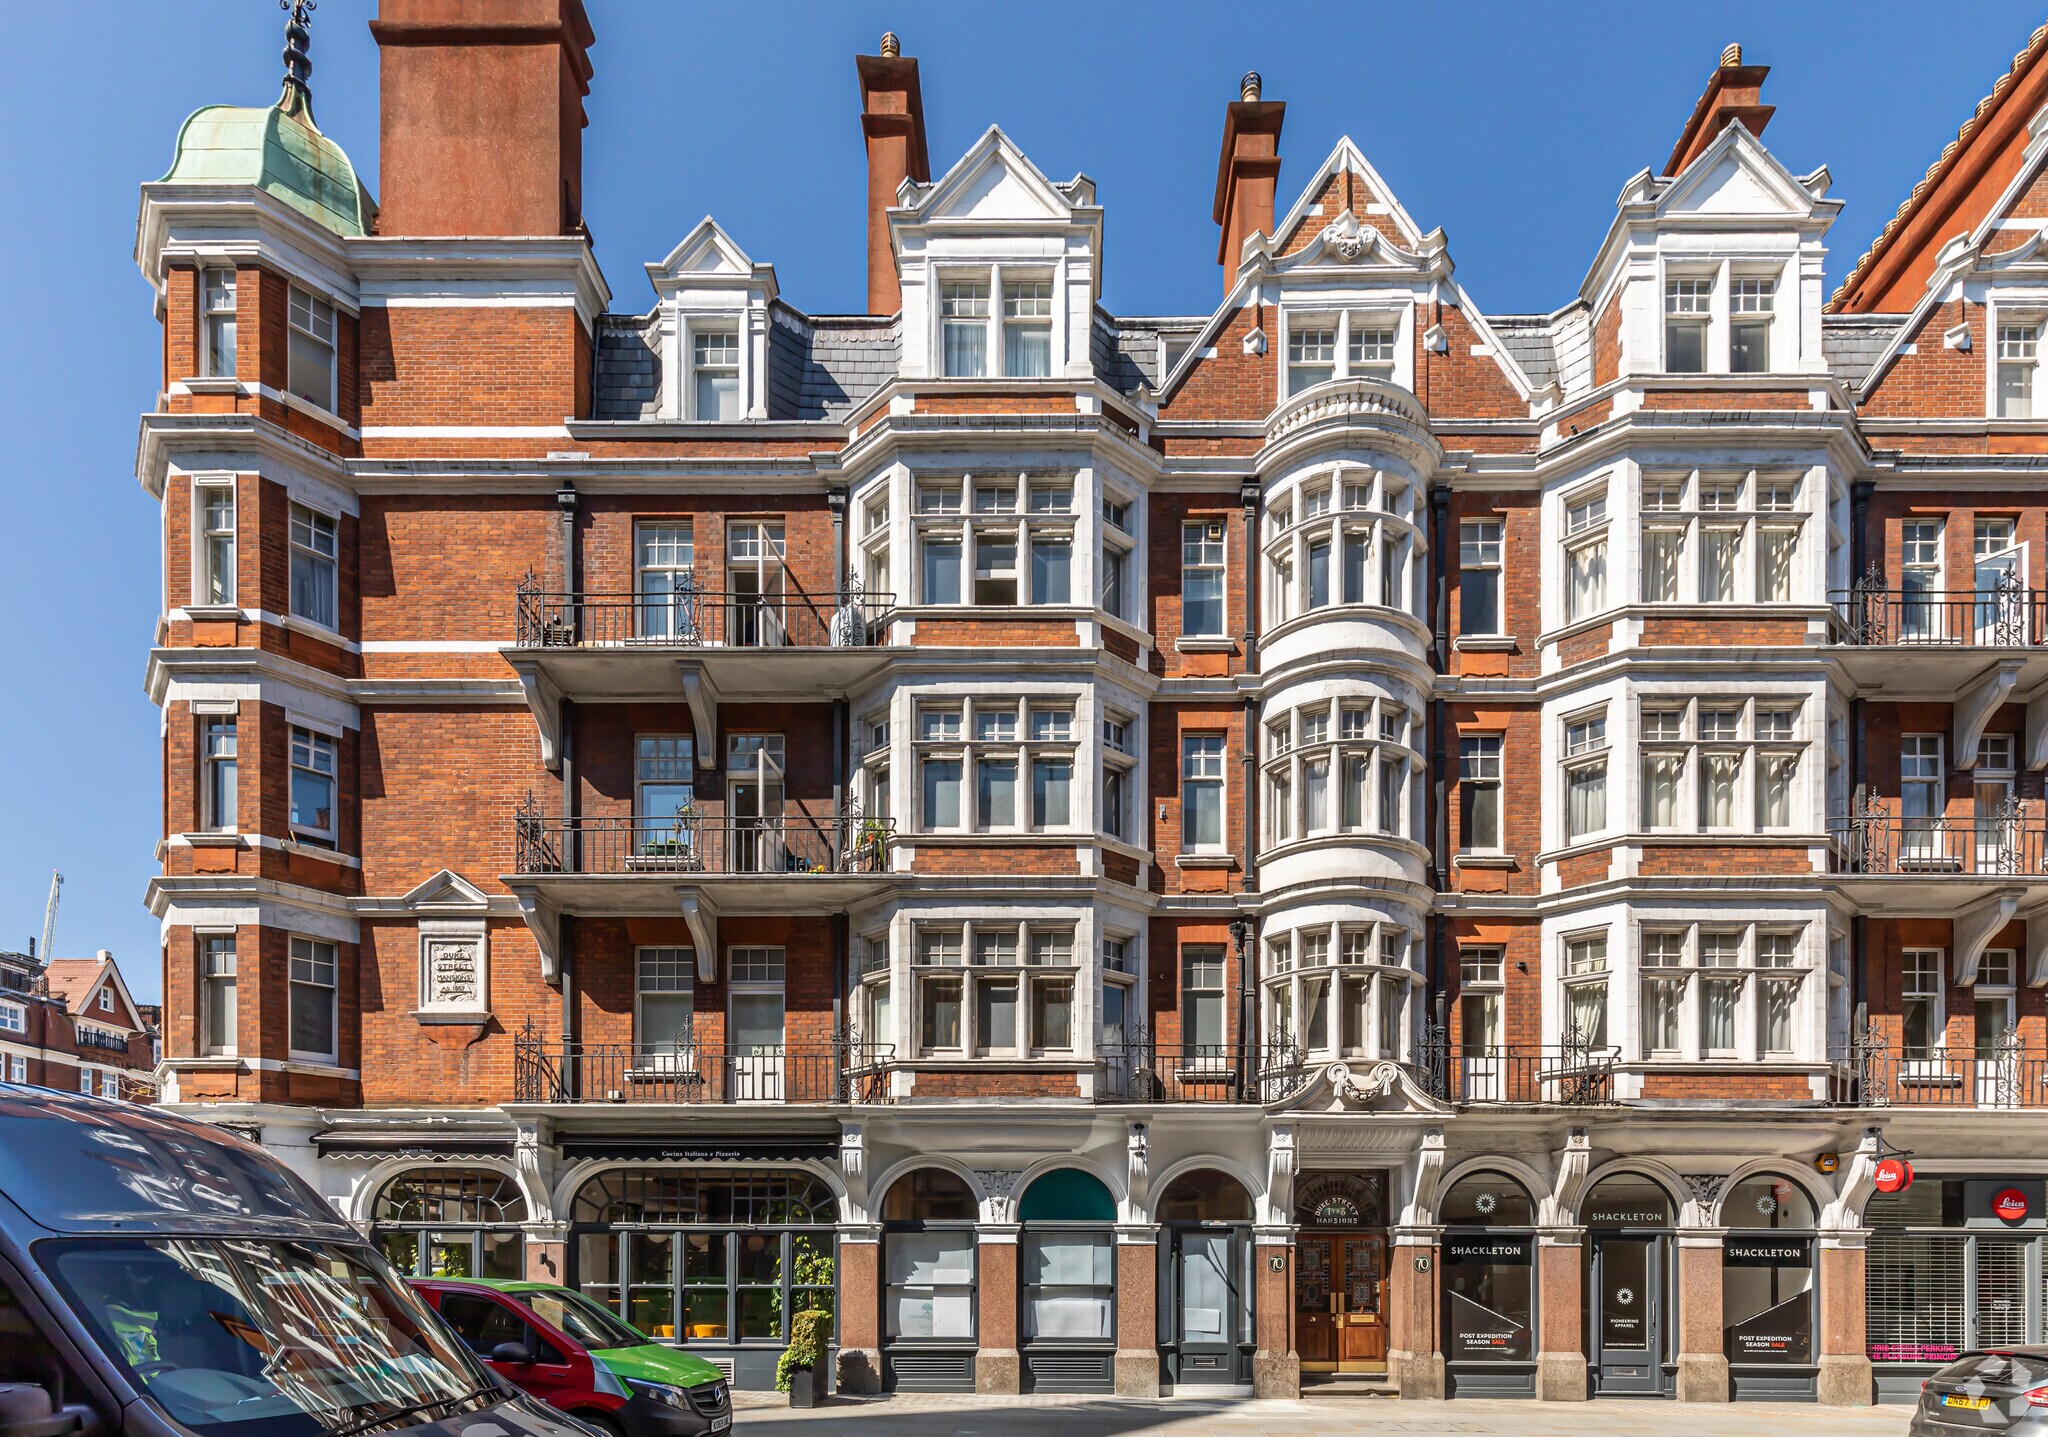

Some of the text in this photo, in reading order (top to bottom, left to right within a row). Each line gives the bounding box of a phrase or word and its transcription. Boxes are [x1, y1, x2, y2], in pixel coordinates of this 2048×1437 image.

[1876, 1169, 1897, 1182] Leica
[1999, 1197, 2025, 1209] Leica
[1592, 1212, 1662, 1221] SHACKLETON
[1451, 1246, 1521, 1255] SHACKLETON
[1729, 1248, 1800, 1257] SHACKLETON
[1270, 1256, 1284, 1270] 70
[1415, 1256, 1429, 1270] 70
